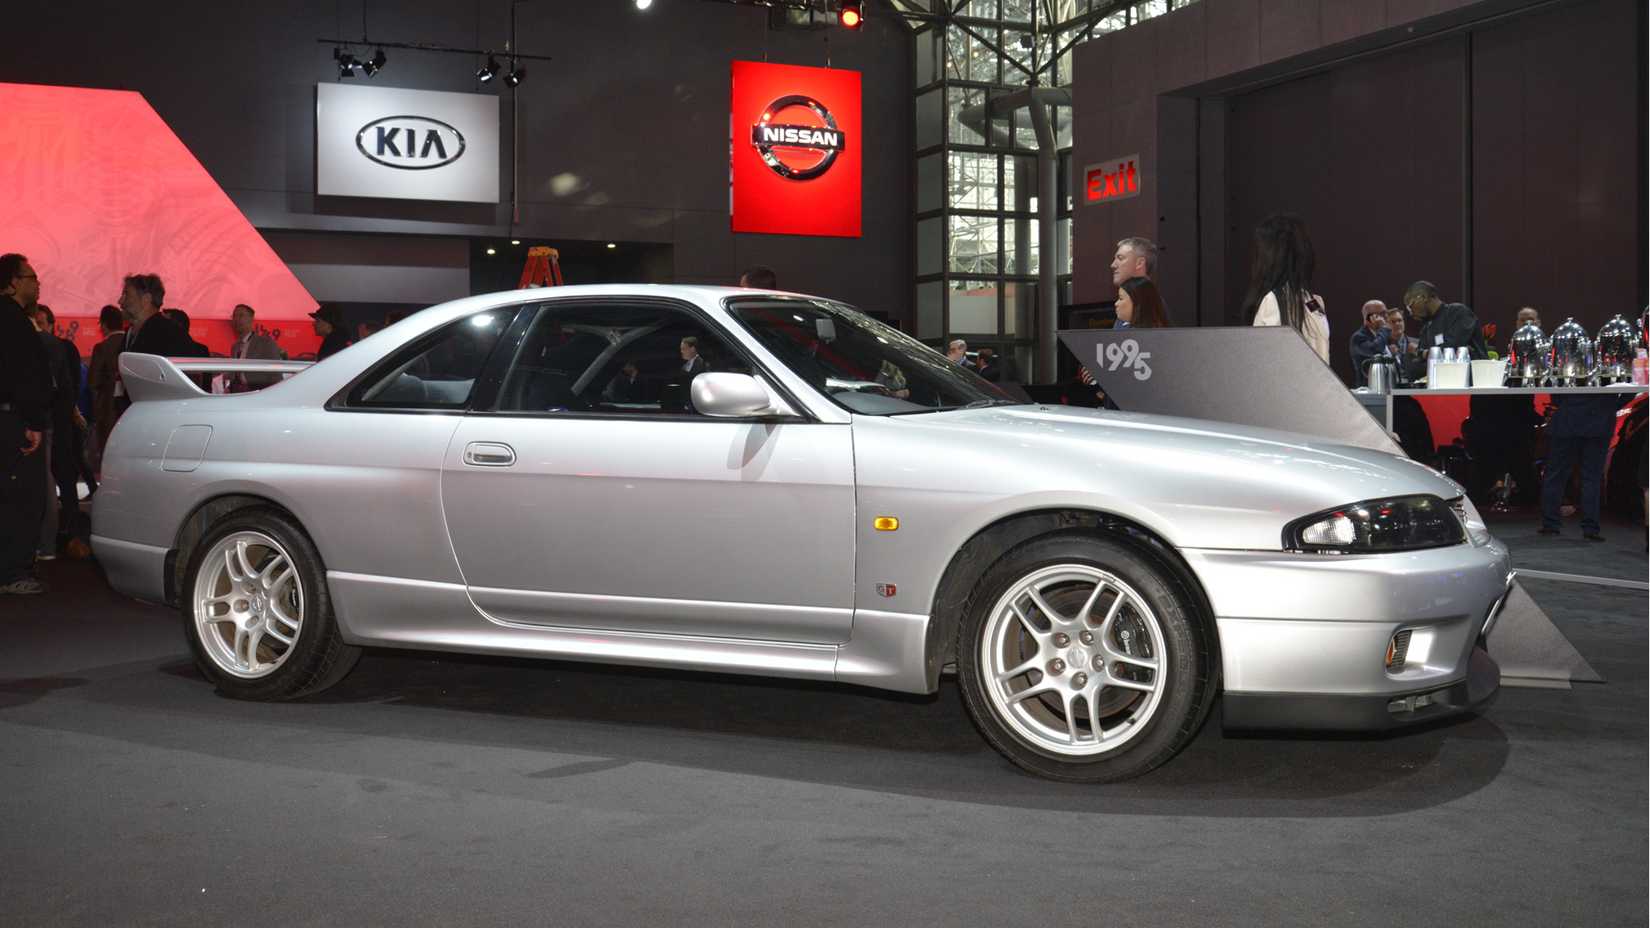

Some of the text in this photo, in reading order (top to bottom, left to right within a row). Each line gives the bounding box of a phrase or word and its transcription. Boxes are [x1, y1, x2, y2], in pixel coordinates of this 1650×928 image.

[376, 126, 448, 159] KIA
[763, 127, 838, 147] NISSAN
[1087, 160, 1137, 201] Exit
[1096, 338, 1152, 381] 1995
